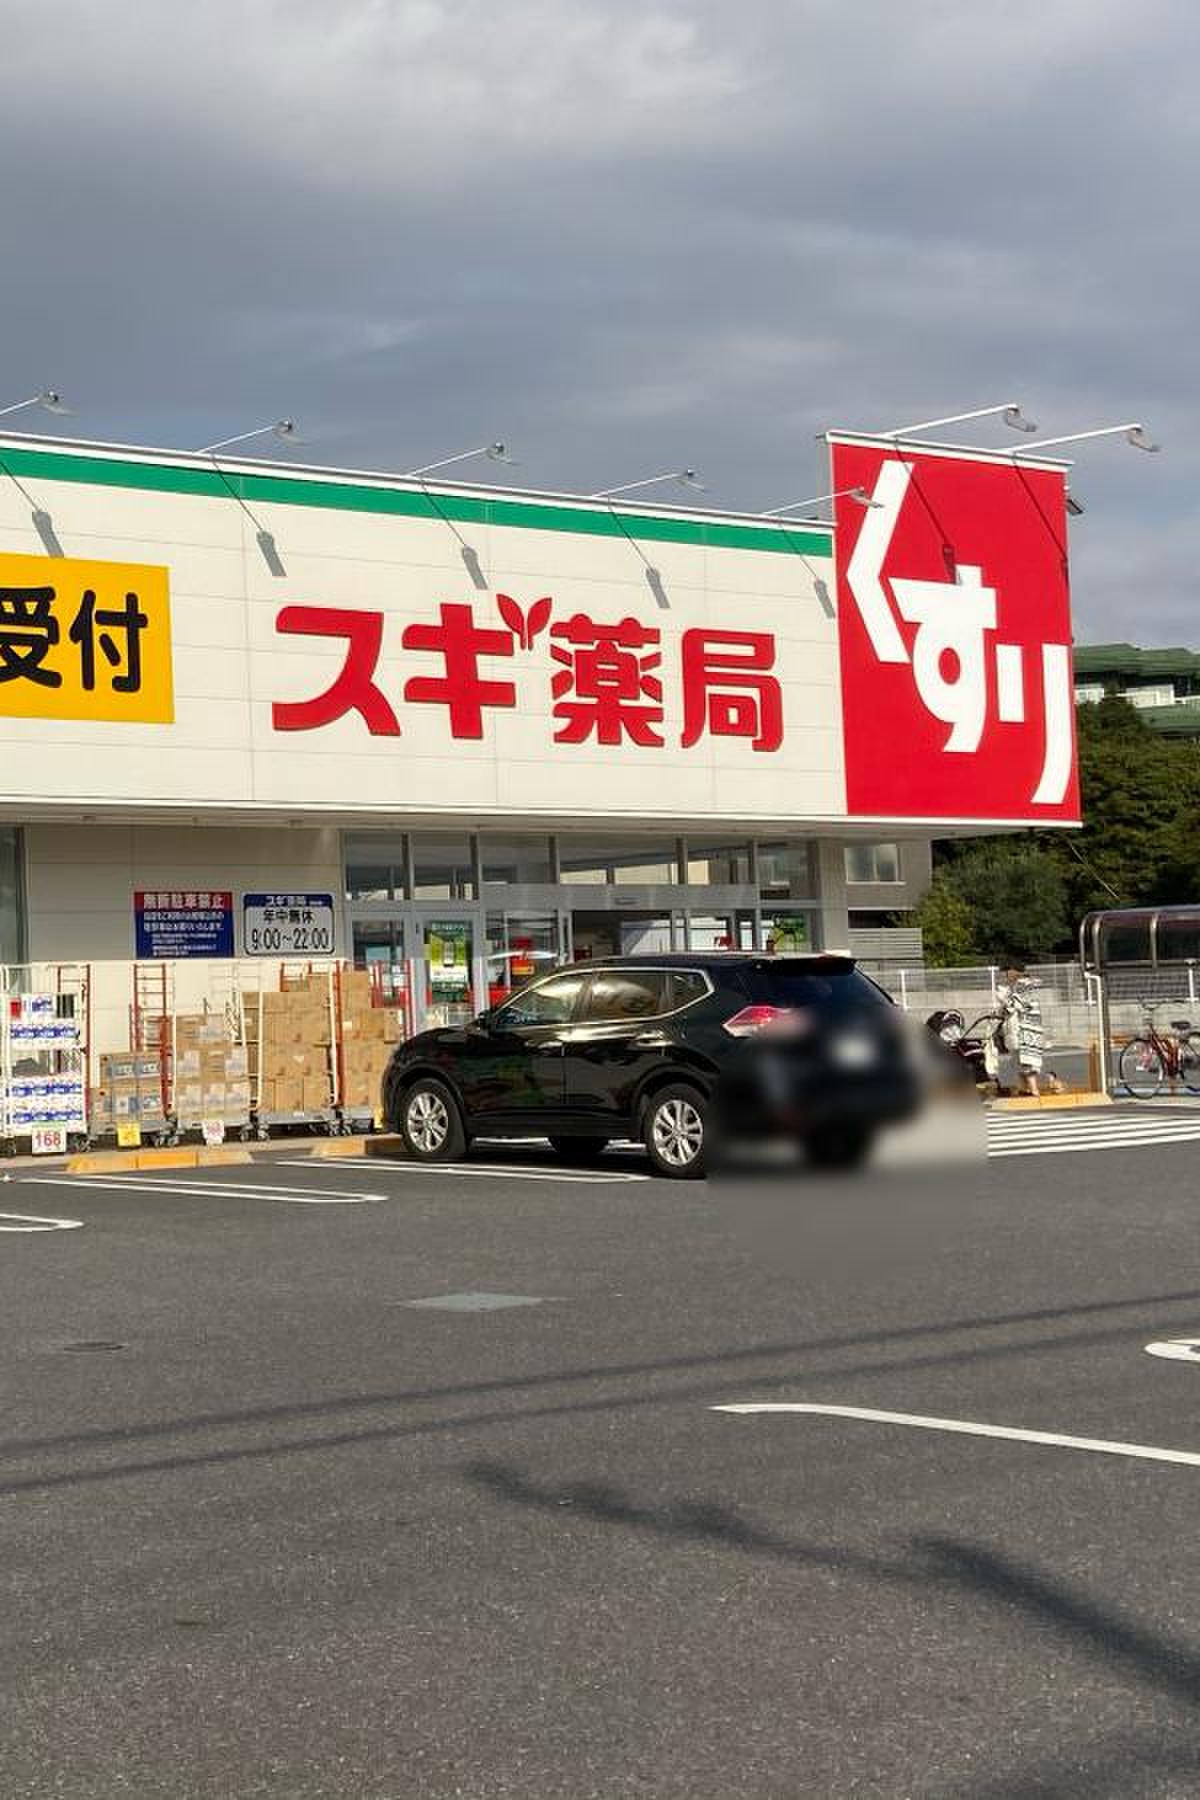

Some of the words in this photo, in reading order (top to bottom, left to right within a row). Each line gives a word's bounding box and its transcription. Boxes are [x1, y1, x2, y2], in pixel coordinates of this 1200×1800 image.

[271, 593, 785, 752] スギ薬局
[846, 459, 1072, 804] くすり
